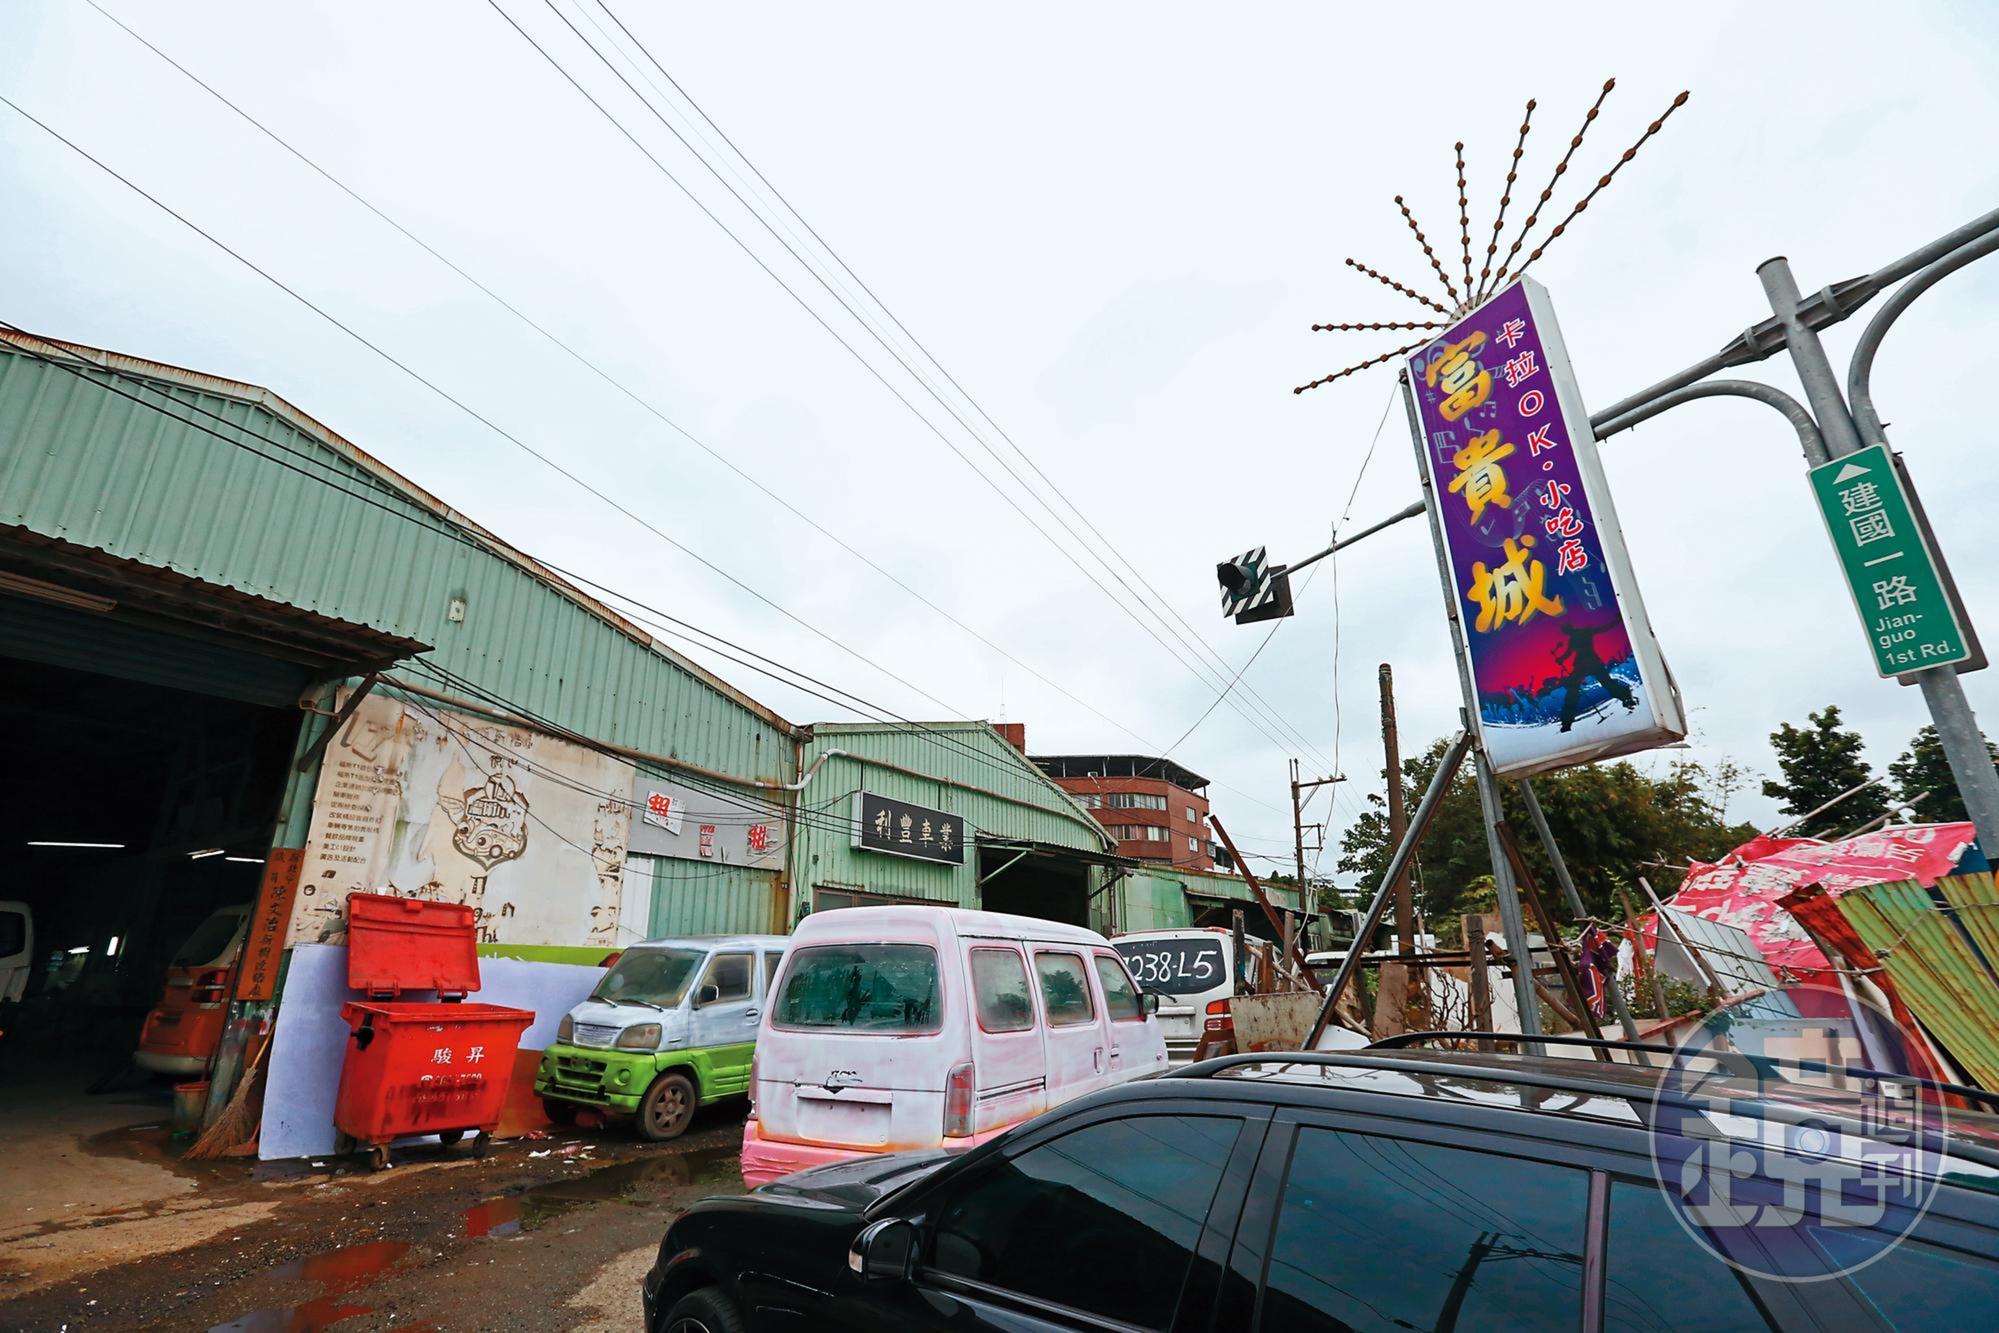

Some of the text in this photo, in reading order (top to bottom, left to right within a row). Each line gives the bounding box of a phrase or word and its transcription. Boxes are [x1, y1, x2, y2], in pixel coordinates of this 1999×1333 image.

[1425, 330, 1564, 633] 富貴城
[1838, 482, 1918, 611] 建國一路
[1876, 613, 1923, 632] Jian-
[1879, 629, 1916, 649] guo
[1885, 641, 1956, 665] 1st Rd.
[1125, 950, 1217, 983] 238-L5
